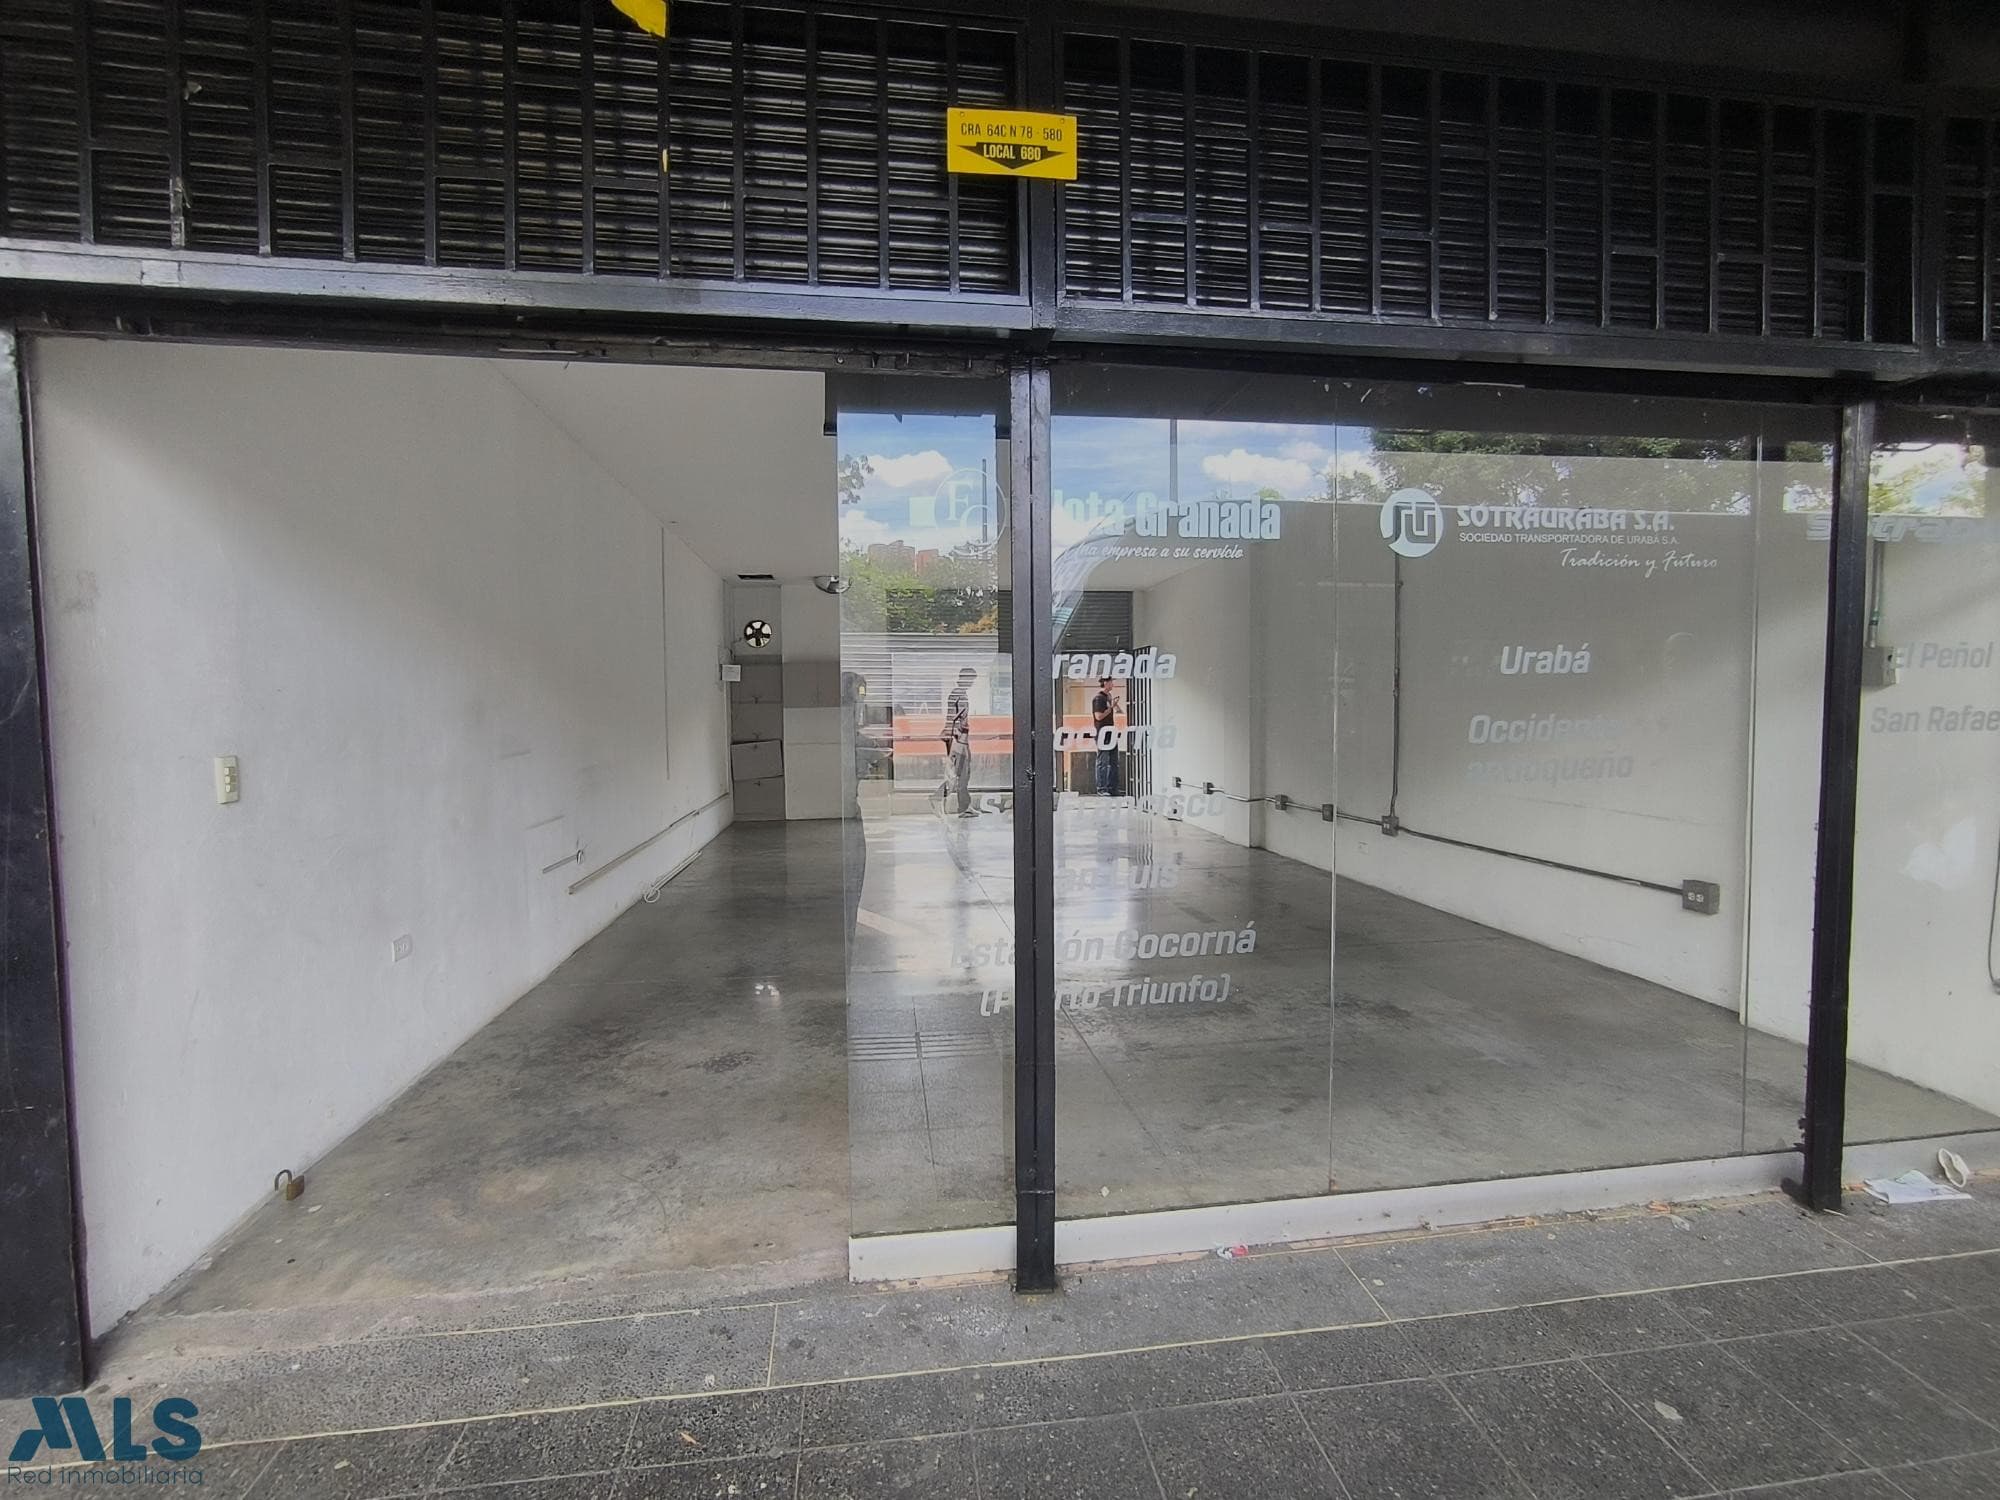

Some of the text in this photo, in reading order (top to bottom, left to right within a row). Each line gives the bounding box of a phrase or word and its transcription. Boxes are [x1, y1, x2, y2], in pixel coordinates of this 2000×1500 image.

[961, 123, 981, 136] CRA
[987, 124, 1006, 137] 64C
[1010, 126, 1017, 137] N
[1021, 126, 1033, 139] 78
[1043, 128, 1062, 141] 580
[983, 144, 1041, 161] LOCAL 680
[1053, 489, 1281, 540] lota Granada
[1102, 545, 1159, 560] empresa
[1160, 548, 1170, 557] a
[1174, 548, 1191, 558] su
[1193, 544, 1244, 559] servicio
[1459, 532, 1512, 544] SOCIEDAD
[1515, 533, 1609, 545] TRANSPORTADORA
[1611, 535, 1625, 545] DE
[1560, 548, 1718, 577] Tradición y Futuro
[1052, 647, 1177, 679] ranada
[1500, 643, 1592, 675] Urabá
[1919, 640, 1994, 669] Peñol
[1053, 714, 1178, 751] ocorná
[1870, 703, 2000, 734] San Rafae
[1113, 920, 1257, 960] Cocorná
[1111, 973, 1231, 1008] Triunfo)
